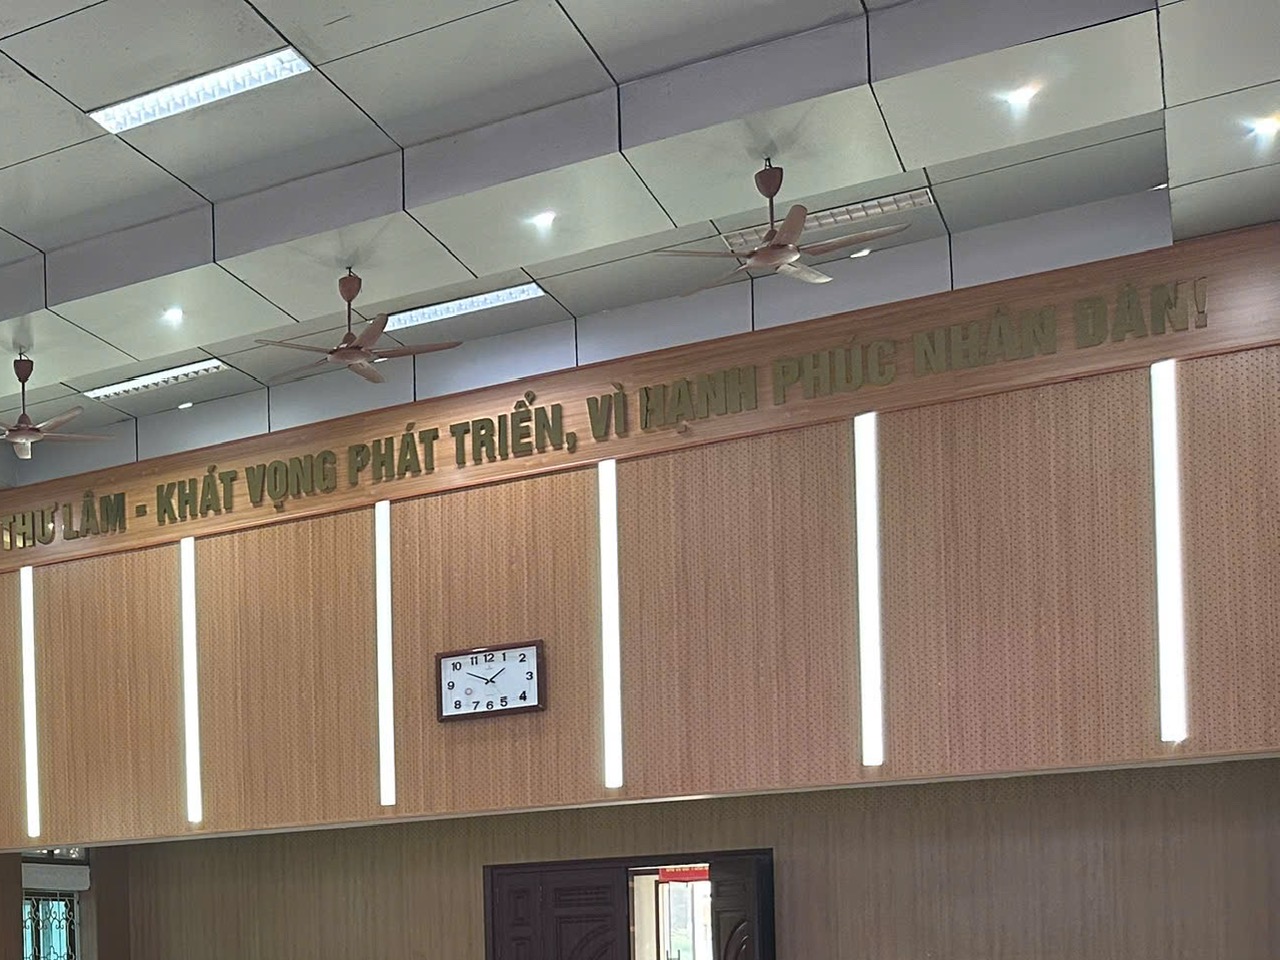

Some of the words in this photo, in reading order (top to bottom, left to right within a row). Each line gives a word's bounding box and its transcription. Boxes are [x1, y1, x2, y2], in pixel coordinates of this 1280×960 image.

[0, 502, 58, 550] THƯ
[62, 489, 126, 540] LÂM
[135, 503, 148, 517] -
[156, 464, 237, 526] KHÁT
[245, 449, 338, 513] VỌNG
[348, 422, 439, 488] PHÁT
[450, 390, 578, 469] TRIỂN,
[586, 382, 627, 441] VÌ
[639, 365, 758, 434] HẠNH
[772, 334, 897, 406] PHÚC
[913, 303, 1058, 378] NHÂN
[470, 656, 478, 665] 11
[483, 653, 495, 663] 12
[519, 653, 526, 663] 2
[451, 662, 462, 671] 10
[526, 671, 533, 680] 3
[447, 681, 455, 690] 9
[519, 691, 527, 701] 4
[454, 700, 462, 709] 8
[472, 701, 480, 710] 7
[486, 701, 494, 710] 6
[500, 696, 508, 707] 5
